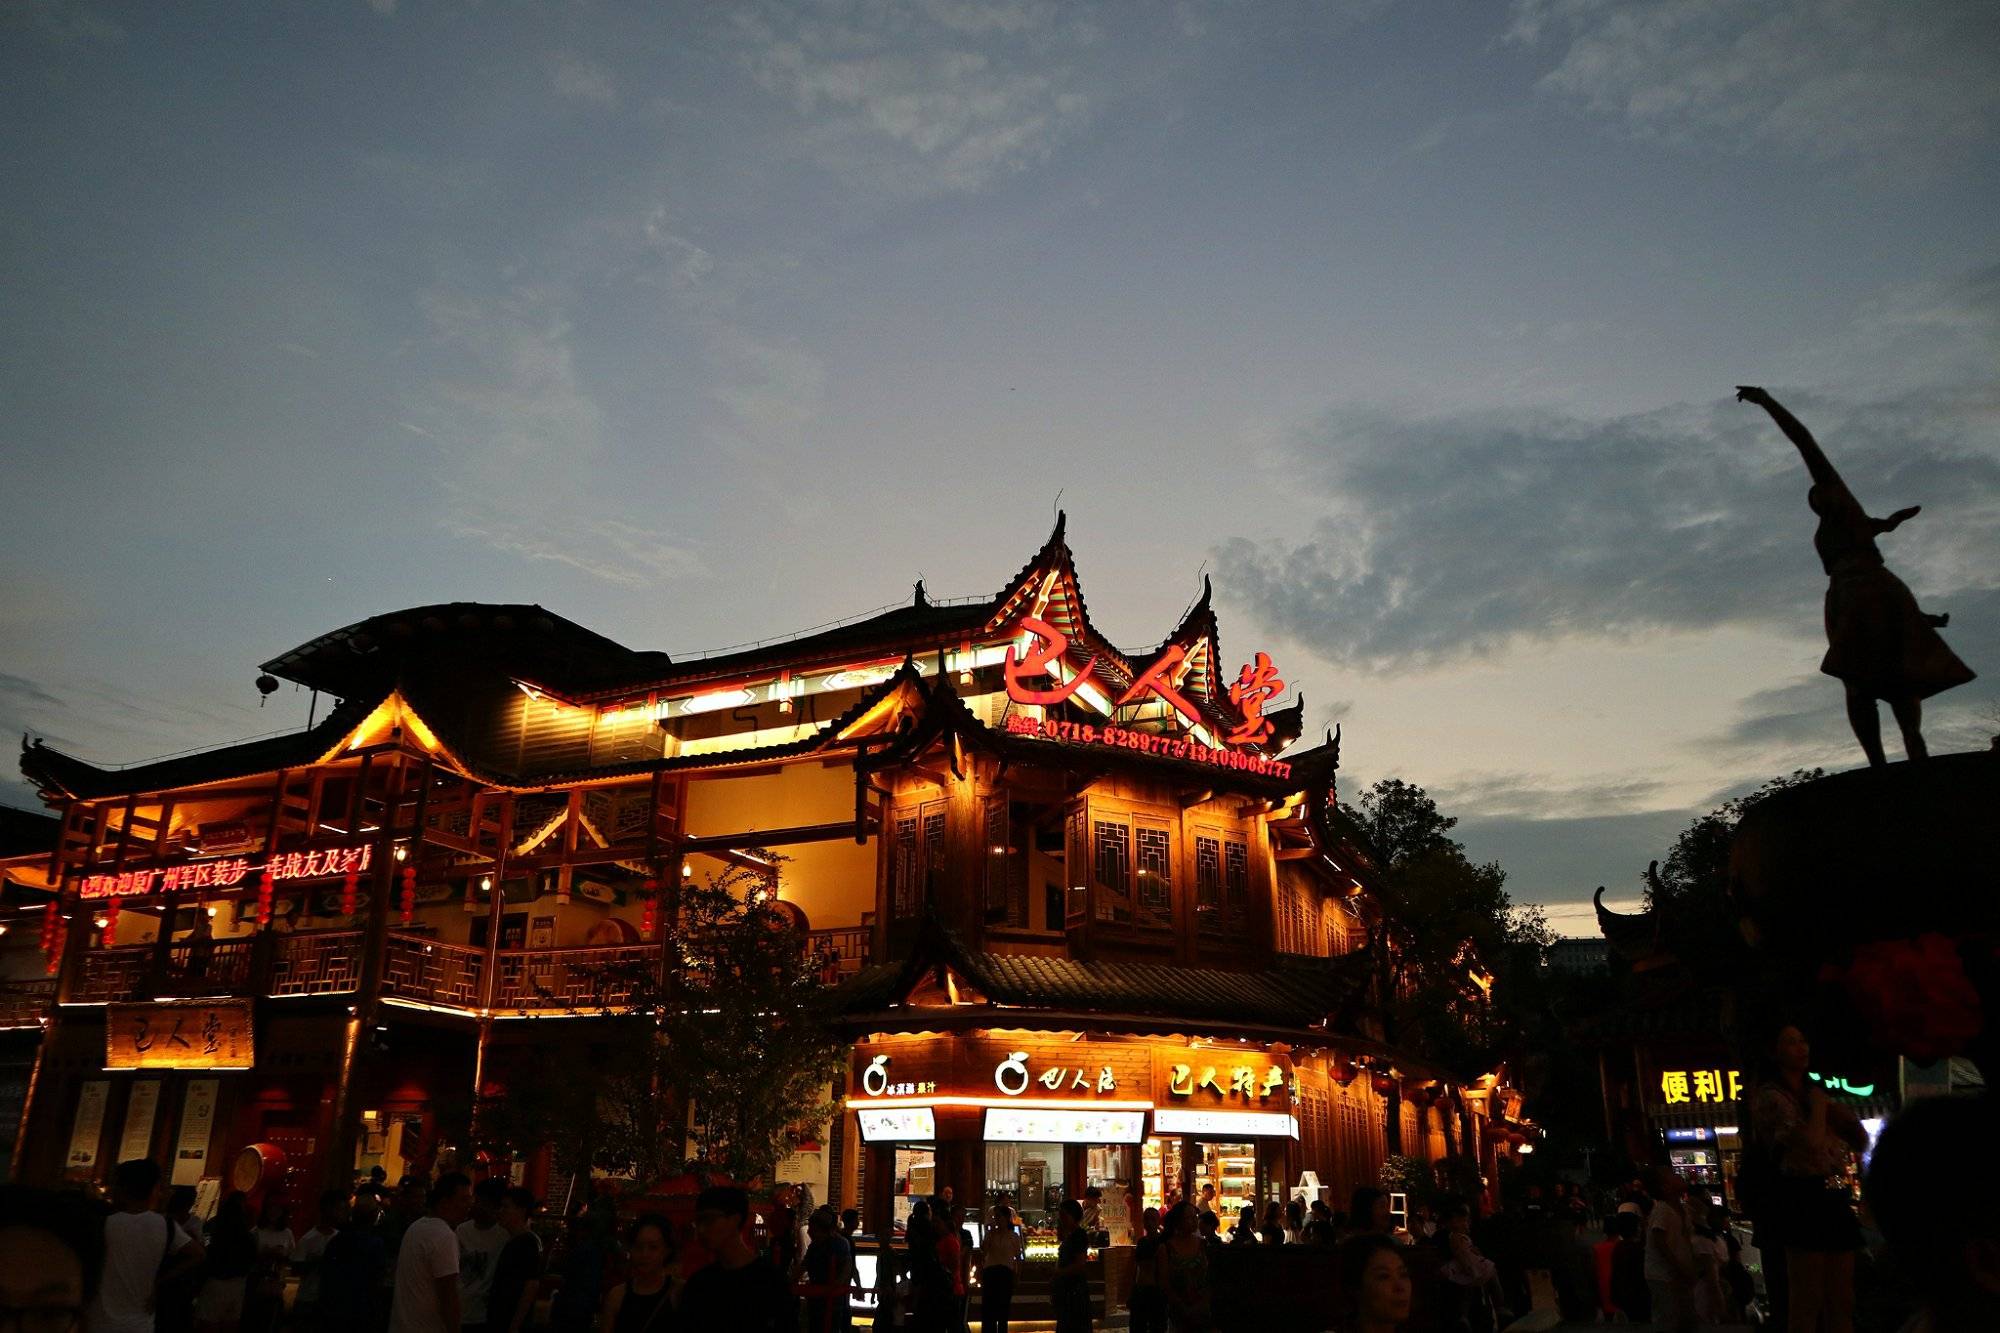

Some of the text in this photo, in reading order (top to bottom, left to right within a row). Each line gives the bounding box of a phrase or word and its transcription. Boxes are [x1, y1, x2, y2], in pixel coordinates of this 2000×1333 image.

[1004, 616, 1285, 745] 巴人堂
[917, 1081, 936, 1095] 果汁
[1170, 1064, 1283, 1099] 巴人特产
